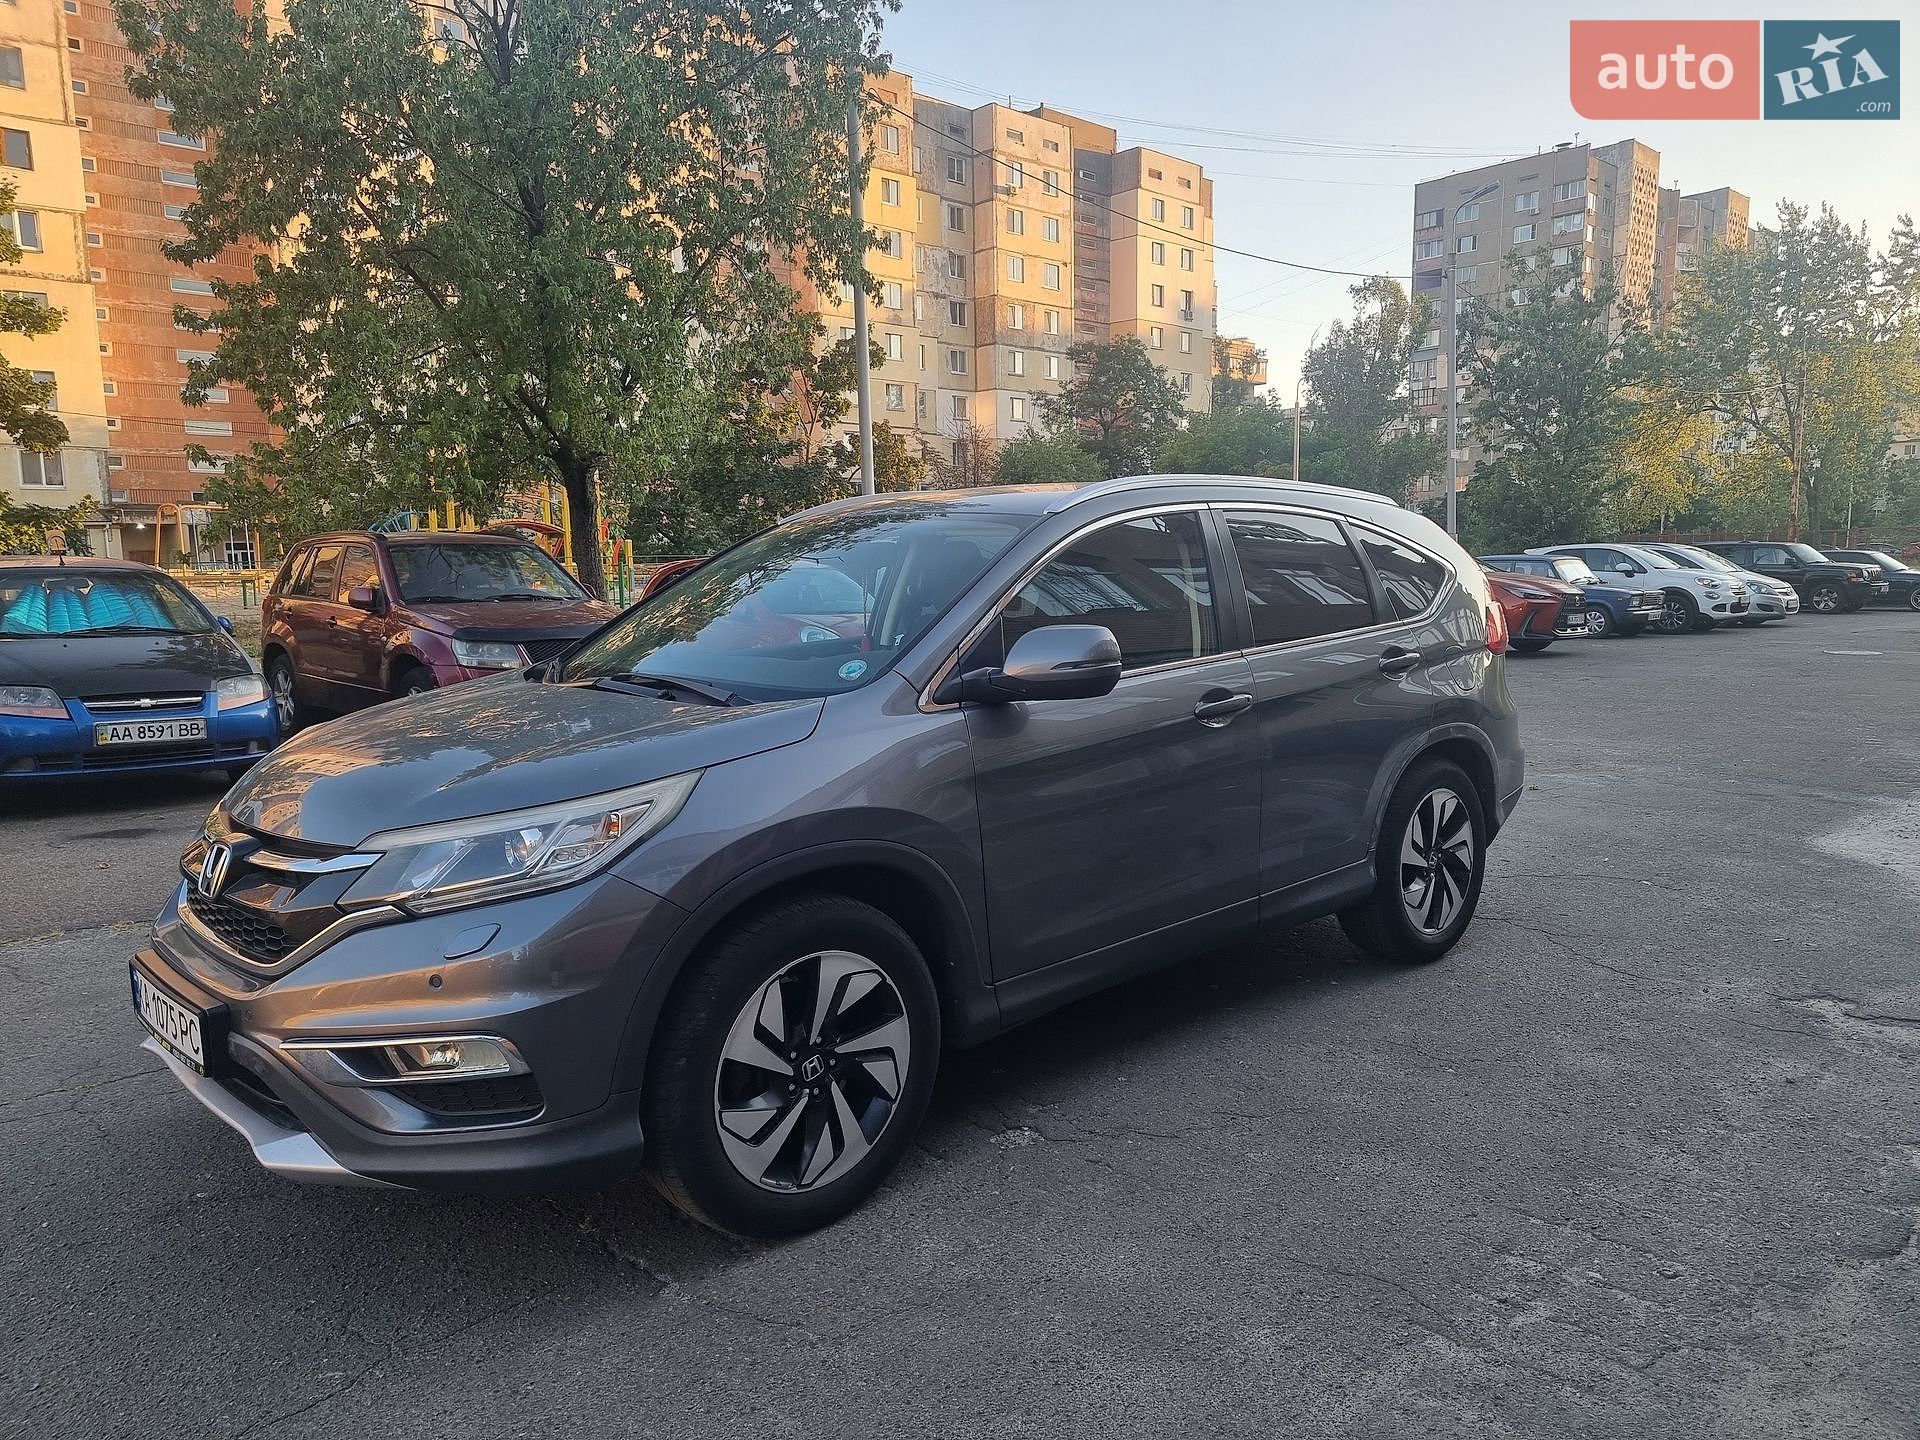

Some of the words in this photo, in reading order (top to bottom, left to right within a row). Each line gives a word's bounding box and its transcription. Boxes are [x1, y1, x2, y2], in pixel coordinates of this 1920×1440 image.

[109, 727, 133, 741] AA
[137, 724, 174, 739] 8591
[179, 723, 201, 737] BB
[152, 992, 178, 1041] 1075
[178, 1011, 200, 1055] PC
